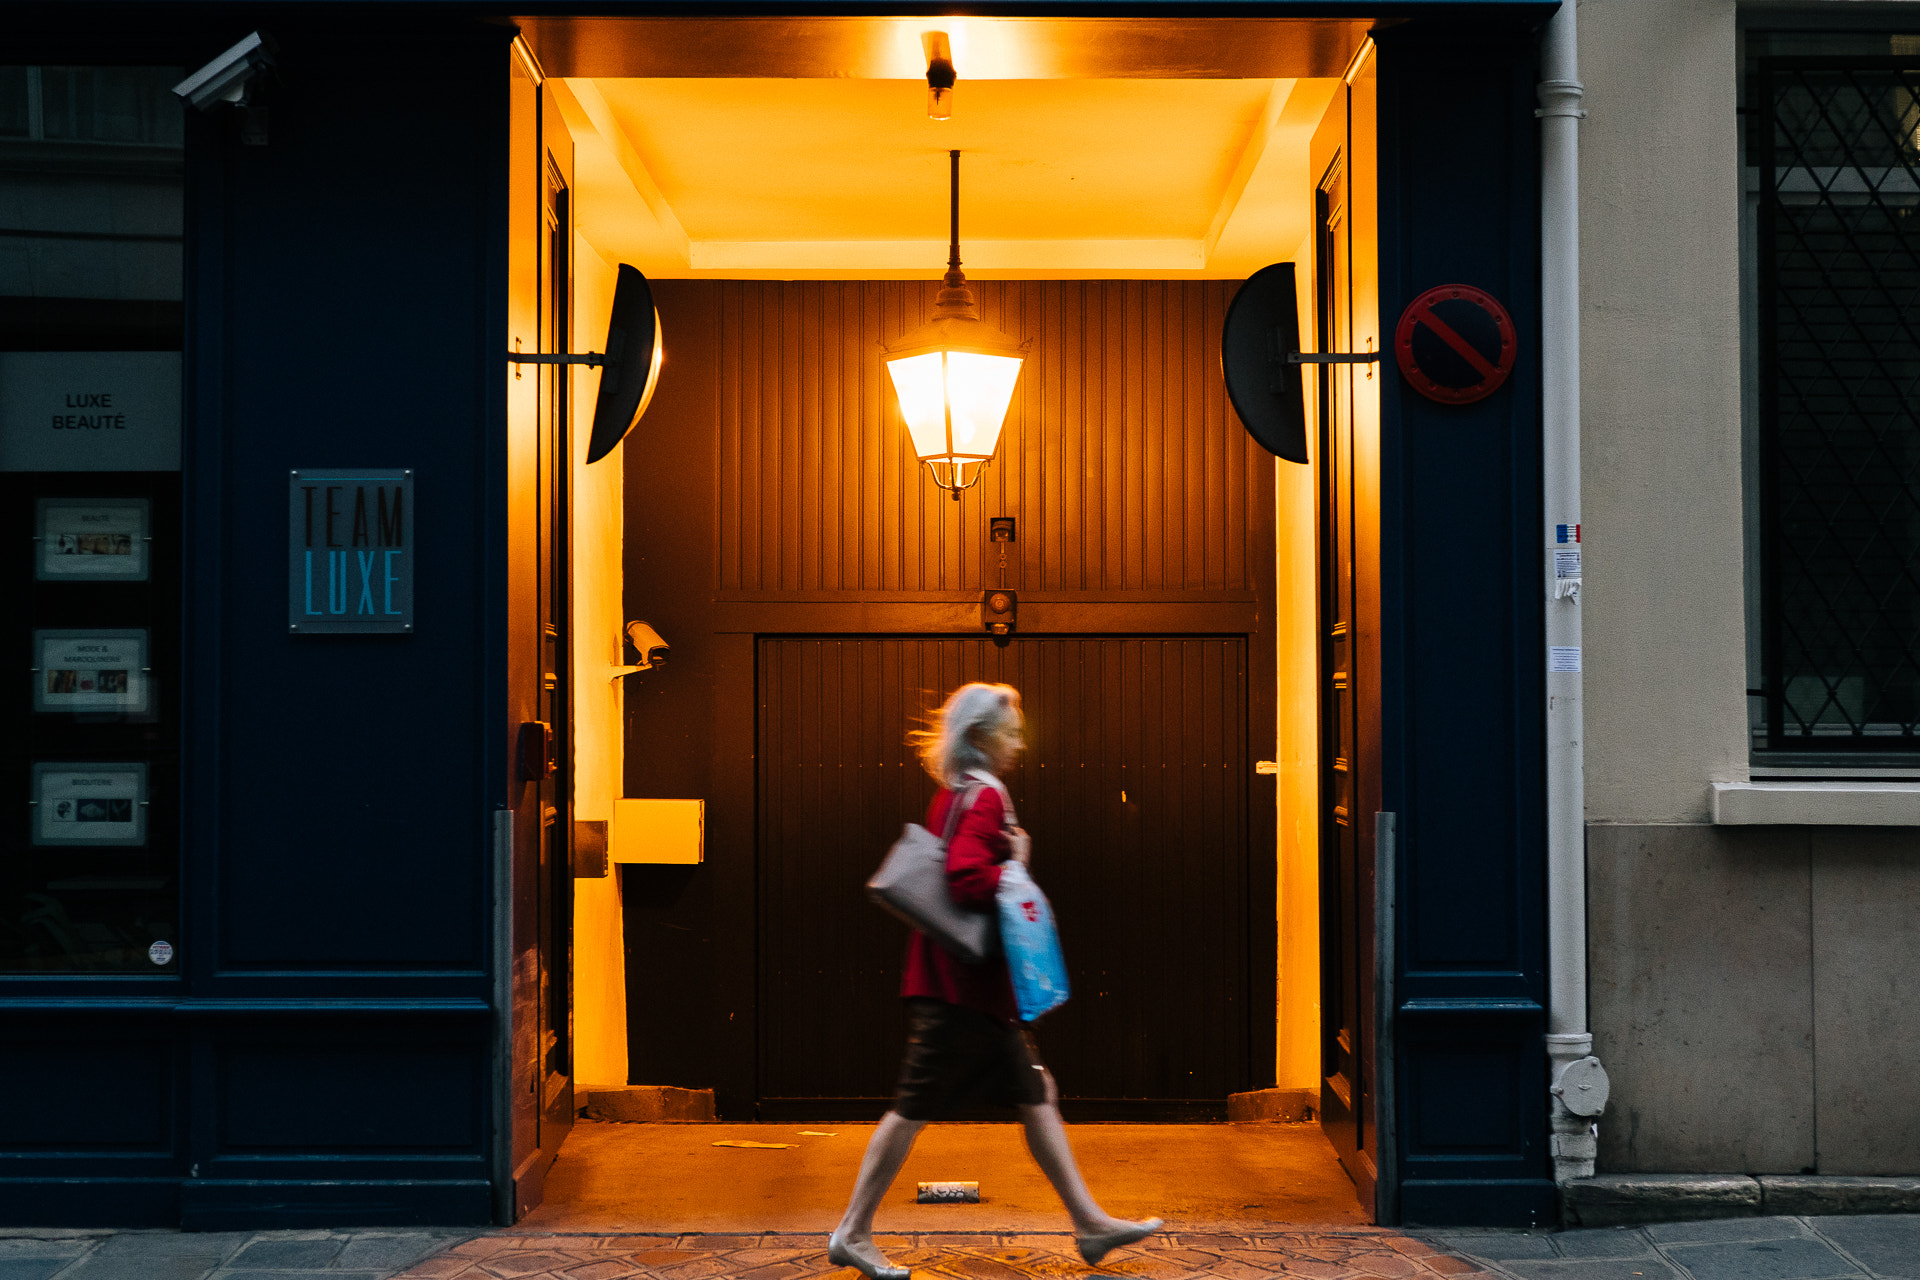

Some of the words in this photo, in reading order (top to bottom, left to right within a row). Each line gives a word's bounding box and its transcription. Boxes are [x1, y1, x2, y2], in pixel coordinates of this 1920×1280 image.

[52, 412, 126, 429] BEAUTÉ
[66, 394, 112, 408] LUXE
[301, 486, 402, 547] TEAM
[304, 550, 403, 615] LUXE
